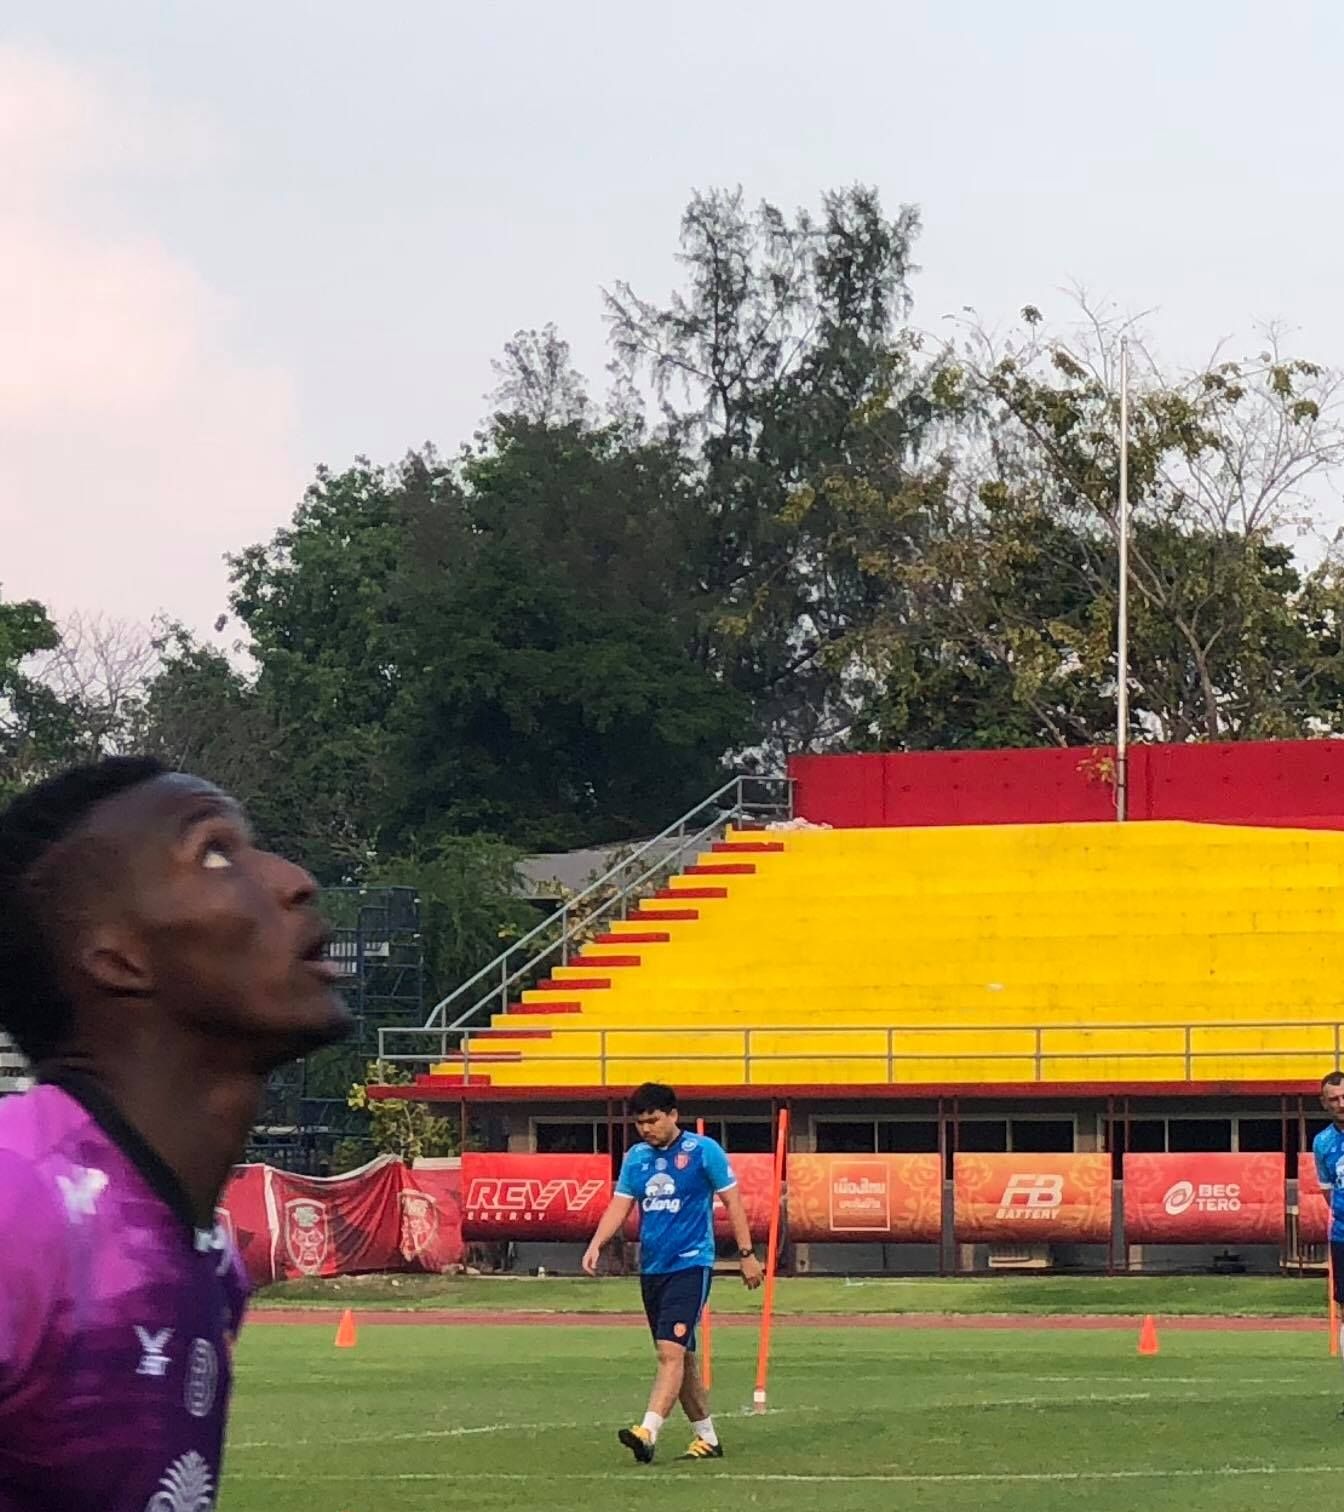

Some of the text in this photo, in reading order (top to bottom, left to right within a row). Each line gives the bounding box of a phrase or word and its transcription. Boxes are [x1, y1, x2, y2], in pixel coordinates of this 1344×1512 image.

[1000, 1174, 1064, 1208] FB
[1199, 1184, 1241, 1197] BEC
[1196, 1198, 1241, 1212] TERO
[467, 1212, 545, 1220] ENERGY
[996, 1208, 1060, 1219] BATTERY
